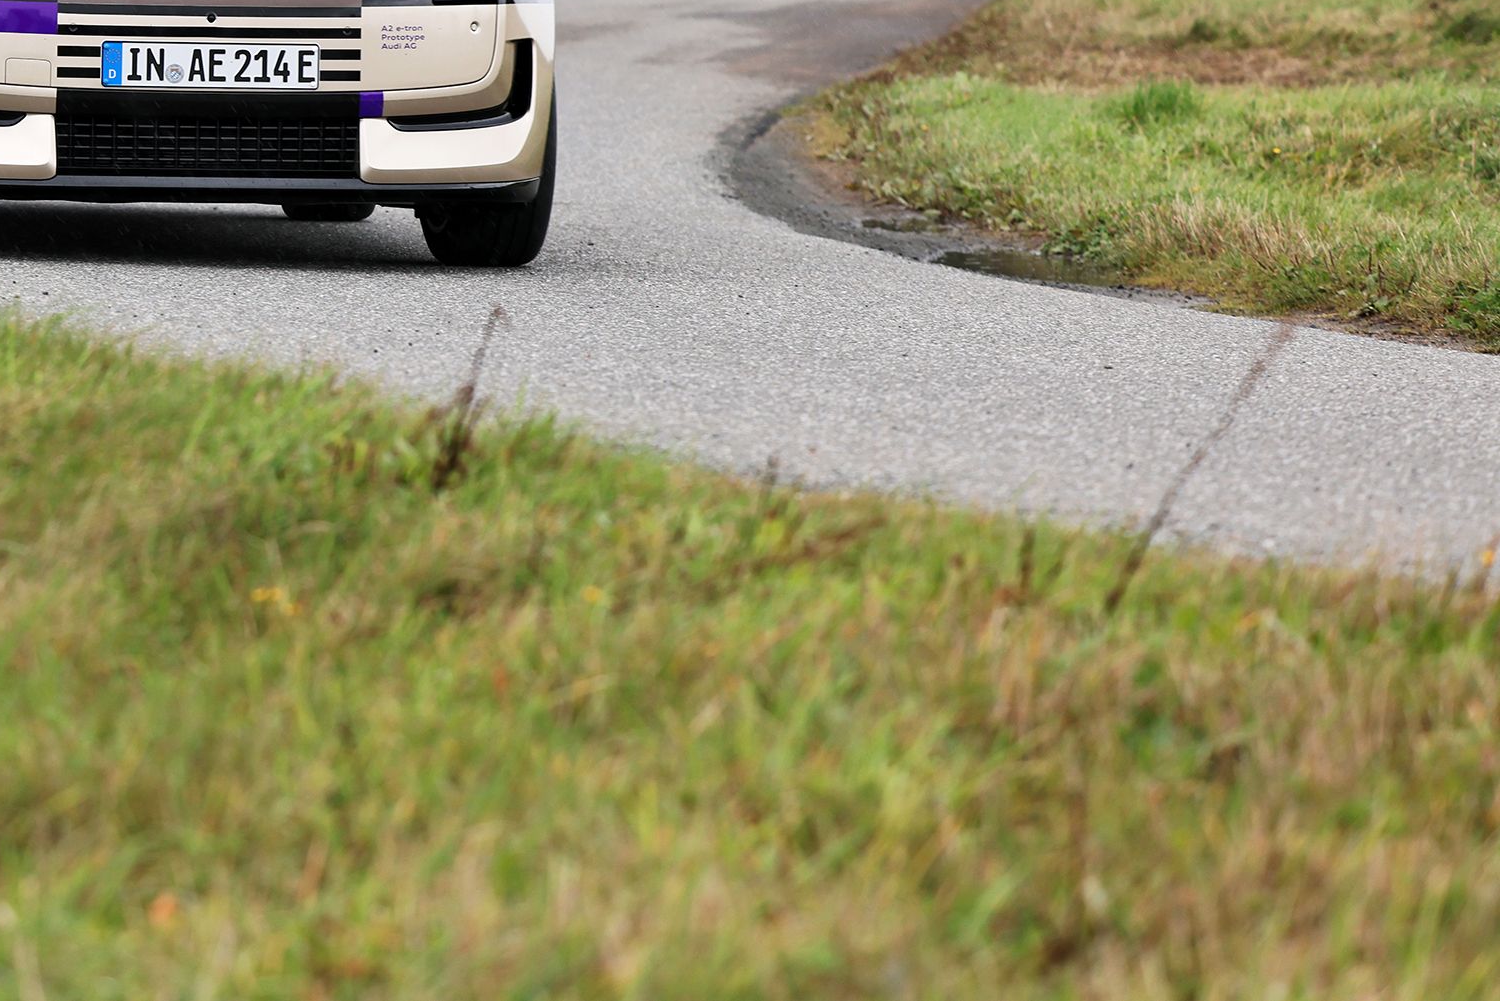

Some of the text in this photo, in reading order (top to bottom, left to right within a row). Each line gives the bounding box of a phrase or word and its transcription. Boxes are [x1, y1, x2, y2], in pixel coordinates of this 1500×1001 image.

[381, 34, 425, 42] Prototype
[404, 42, 417, 50] AG
[127, 47, 165, 82] IN
[108, 69, 117, 79] D
